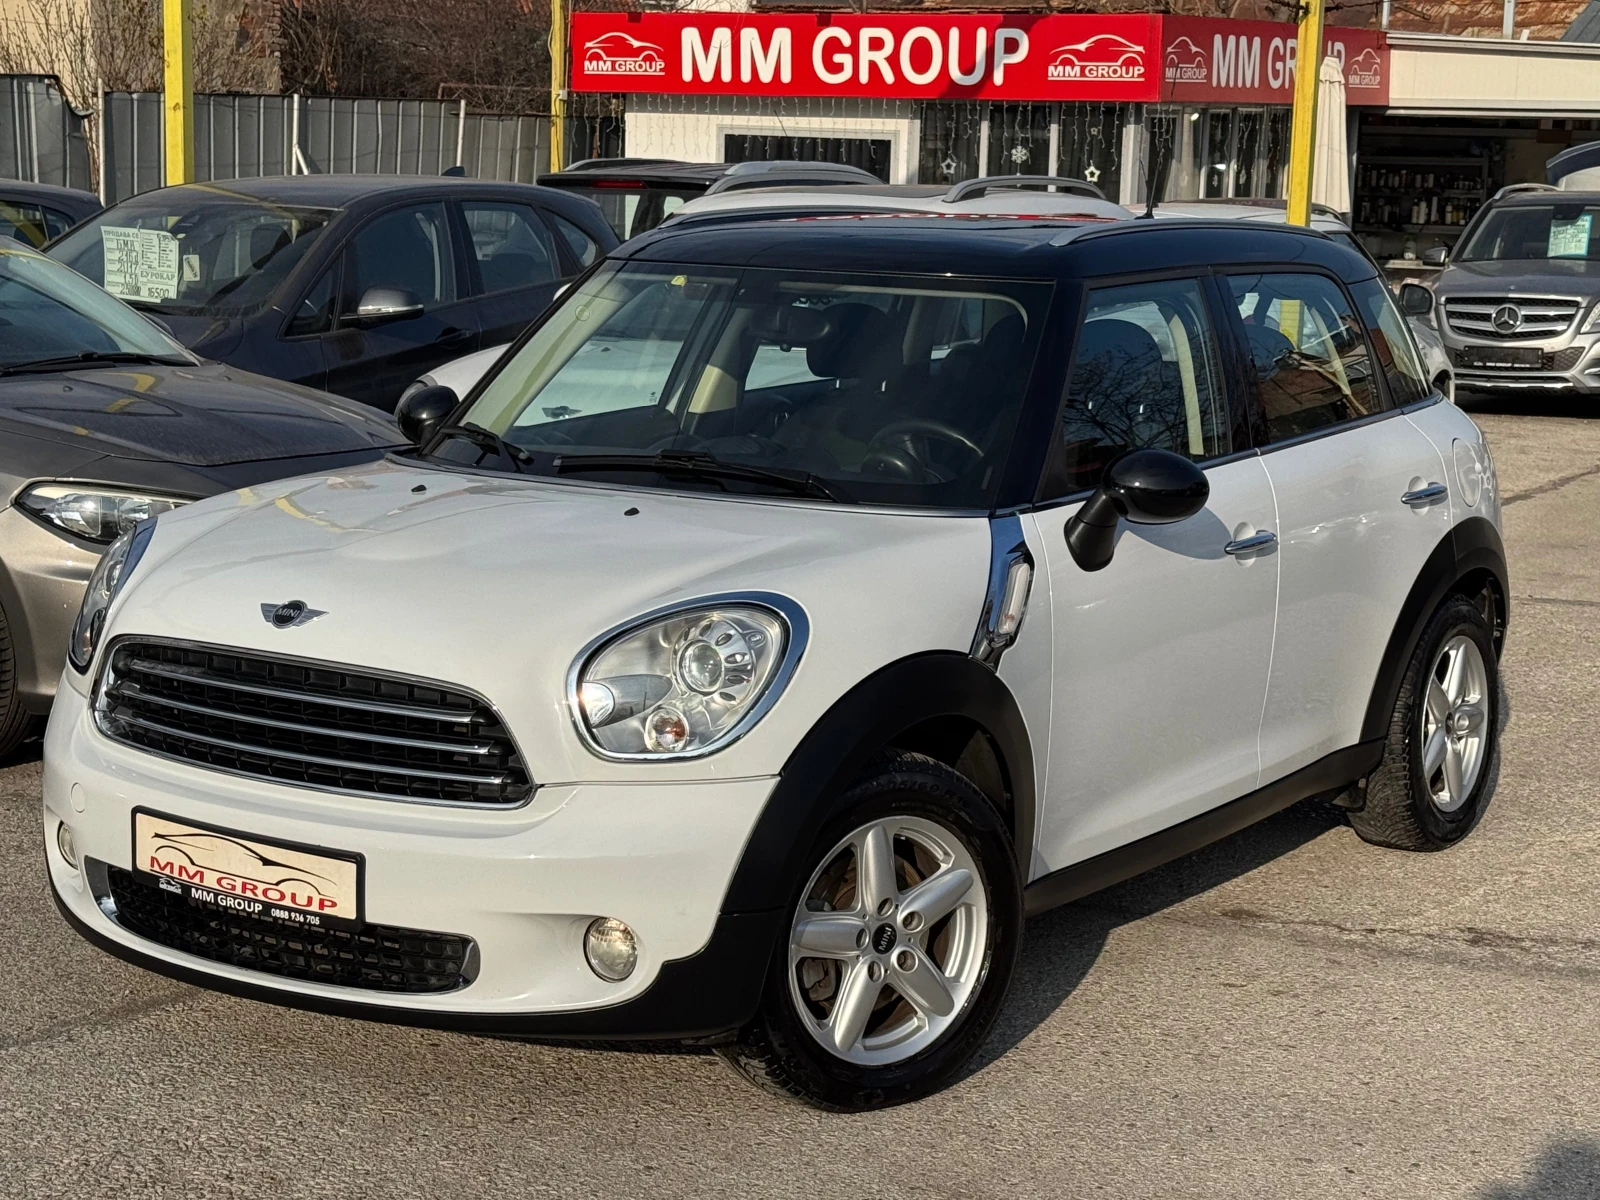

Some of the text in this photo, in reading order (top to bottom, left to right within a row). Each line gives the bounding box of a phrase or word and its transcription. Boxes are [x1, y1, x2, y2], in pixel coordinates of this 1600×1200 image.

[681, 26, 1030, 87] MM GROUP
[1212, 33, 1346, 90] MM GRP
[584, 60, 665, 73] MM GROUP
[1047, 65, 1145, 79] MM GROUP
[1165, 67, 1208, 80] MM GROUP
[1348, 75, 1380, 85] MM GROUP
[104, 230, 131, 239] ПРОДАВА
[277, 607, 301, 618] MINI
[149, 856, 338, 911] MM GROUP
[191, 887, 215, 904] MM
[217, 895, 263, 914] GROUP
[271, 908, 290, 920] 0888
[290, 912, 305, 923] 936
[305, 915, 320, 926] 705
[878, 926, 893, 951] MINI
